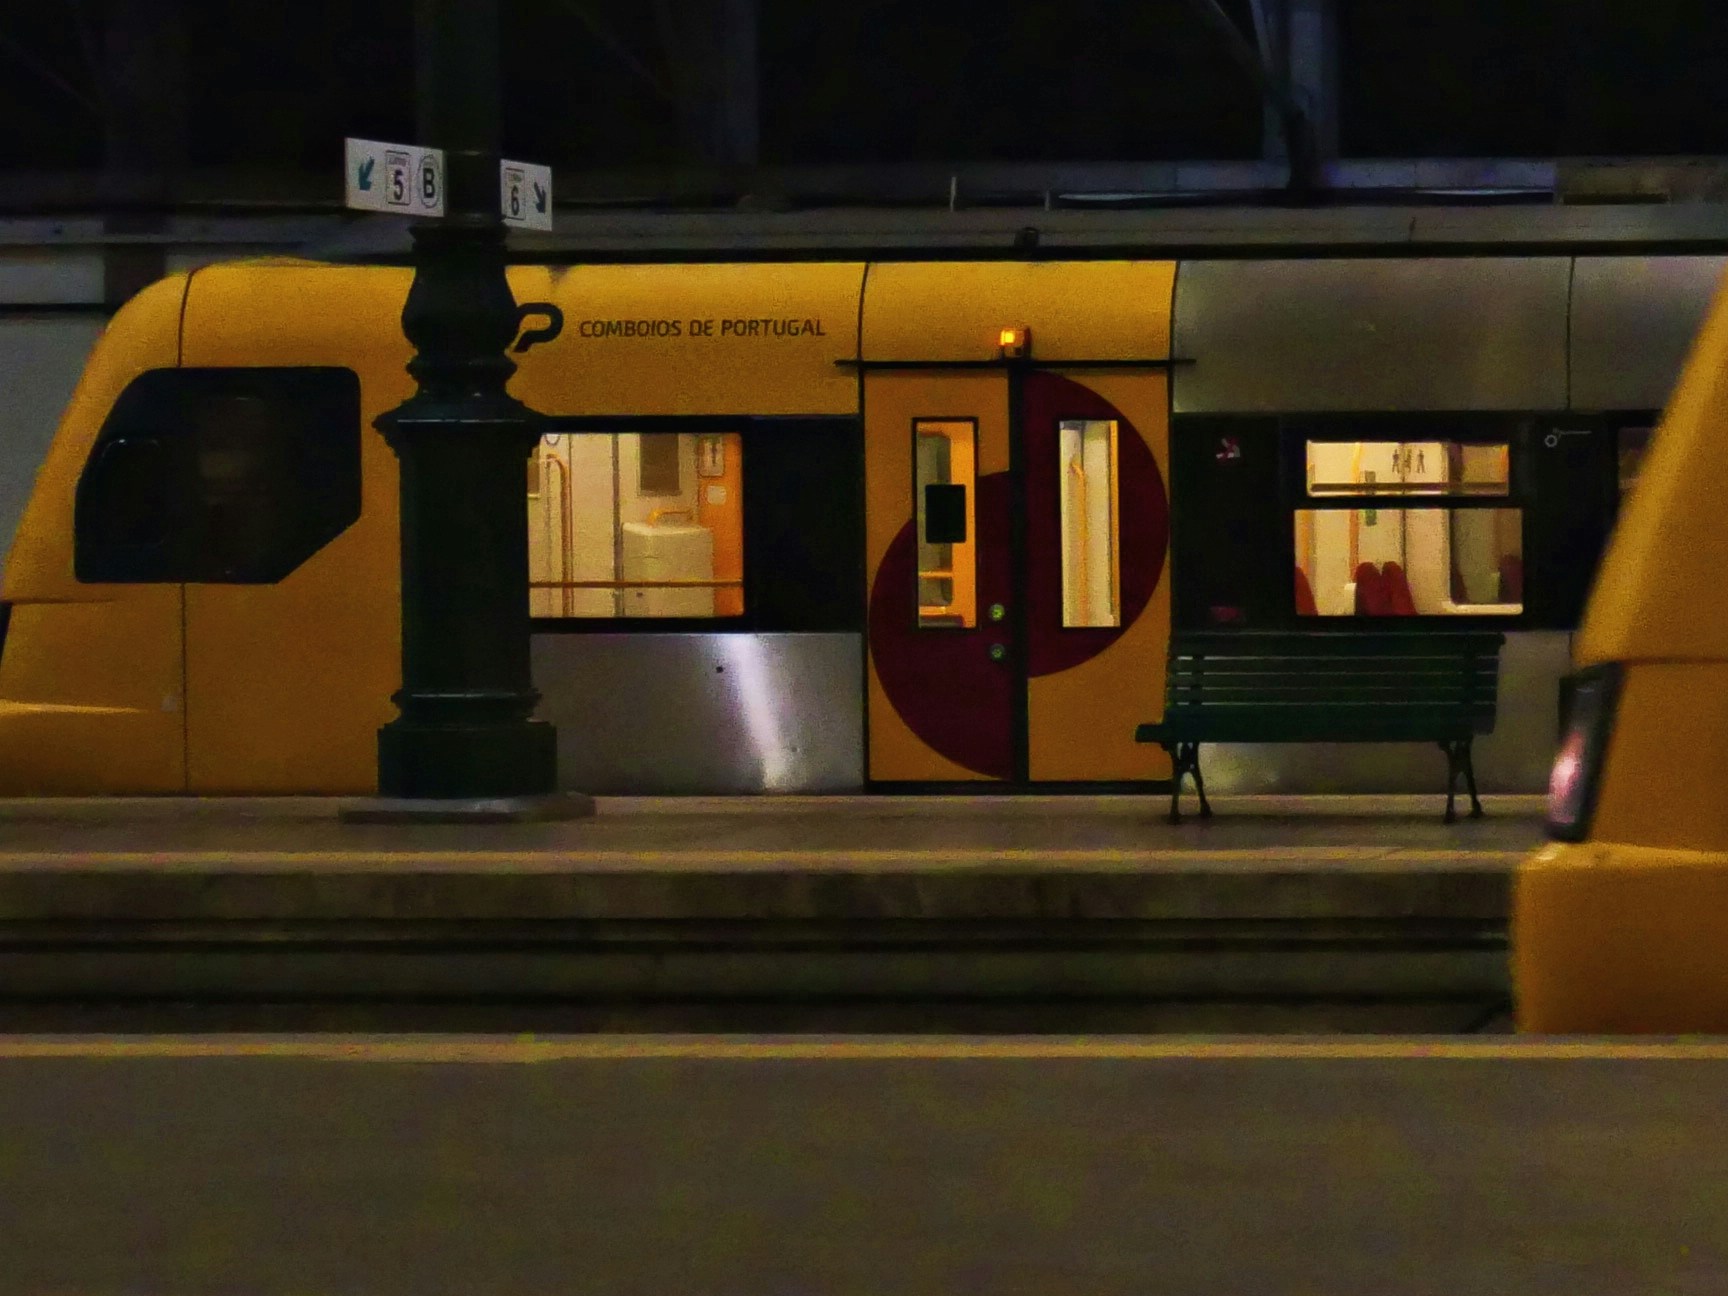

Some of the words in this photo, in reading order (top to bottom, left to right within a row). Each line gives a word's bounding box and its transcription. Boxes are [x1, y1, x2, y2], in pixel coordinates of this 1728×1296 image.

[393, 169, 404, 200] 5
[422, 168, 436, 198] B
[510, 186, 520, 216] 6
[579, 320, 682, 338] COMBOIOS
[689, 319, 713, 337] DE
[721, 319, 826, 337] PORTUGAL
